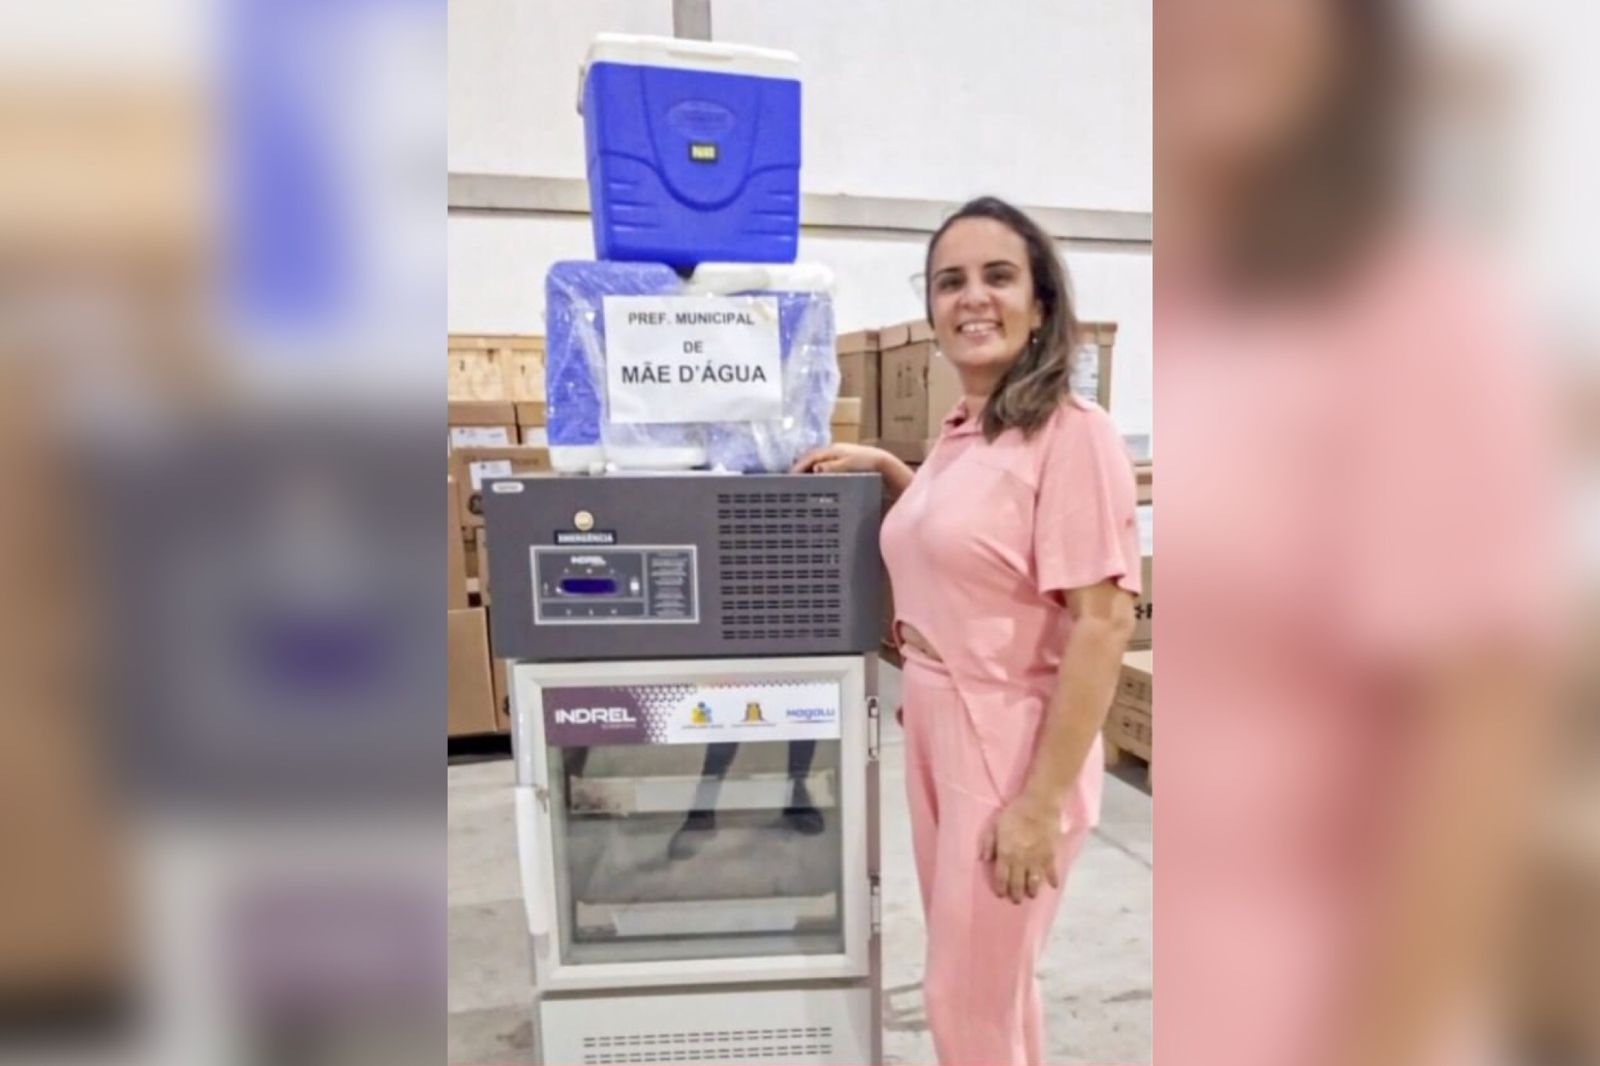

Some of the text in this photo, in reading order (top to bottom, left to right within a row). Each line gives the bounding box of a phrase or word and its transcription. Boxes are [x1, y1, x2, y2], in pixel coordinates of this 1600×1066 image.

[628, 312, 755, 325] PREF. MUNICIPAL
[683, 341, 703, 354] DE
[621, 360, 767, 383] MÃE D'ÁGUA
[555, 707, 637, 724] INDREL
